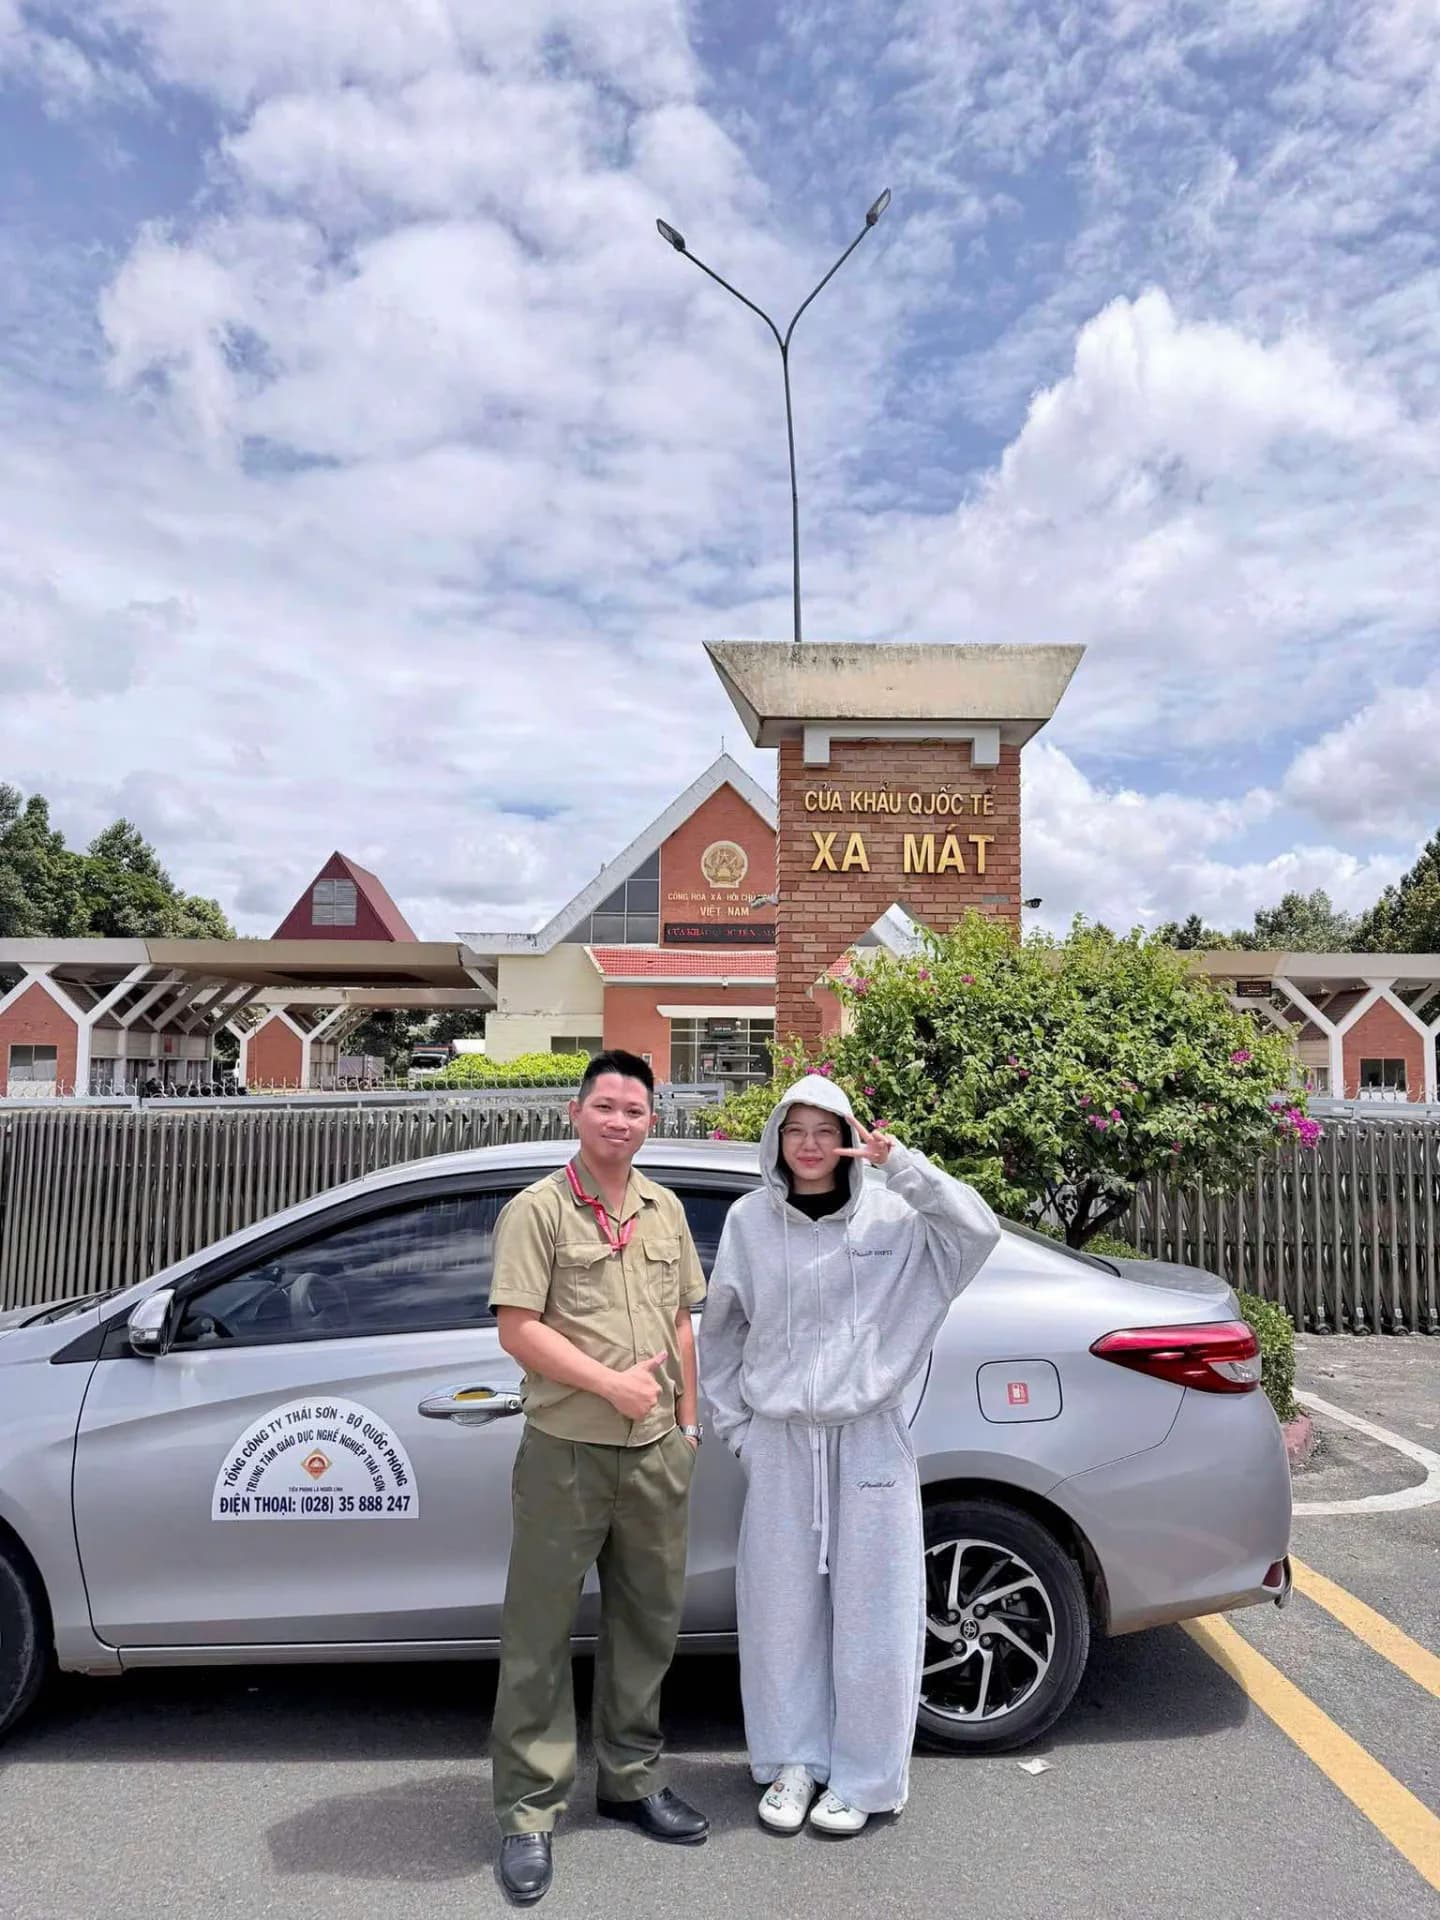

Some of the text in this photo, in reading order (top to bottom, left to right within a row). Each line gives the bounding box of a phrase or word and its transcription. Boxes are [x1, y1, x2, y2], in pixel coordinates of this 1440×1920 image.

[811, 824, 995, 874] XA MÁT
[727, 905, 750, 917] NAM
[223, 1457, 247, 1487] TỔNG
[242, 1429, 270, 1458] CÔNG
[267, 1418, 282, 1433] TY
[285, 1406, 311, 1425] THÁI
[315, 1405, 338, 1420] SƠN
[346, 1412, 364, 1429] BỘ
[362, 1423, 389, 1451] QUỐC
[383, 1448, 408, 1487] PHÒNG
[246, 1464, 265, 1493] TRUNG
[259, 1447, 278, 1467] TÂM
[276, 1434, 296, 1452] GIÁO
[297, 1428, 314, 1444] DỤC
[362, 1454, 381, 1475] THÁI
[372, 1474, 386, 1493] SƠN
[219, 1492, 411, 1516] ĐIỆN THOẠI: (028) 35 888 247
